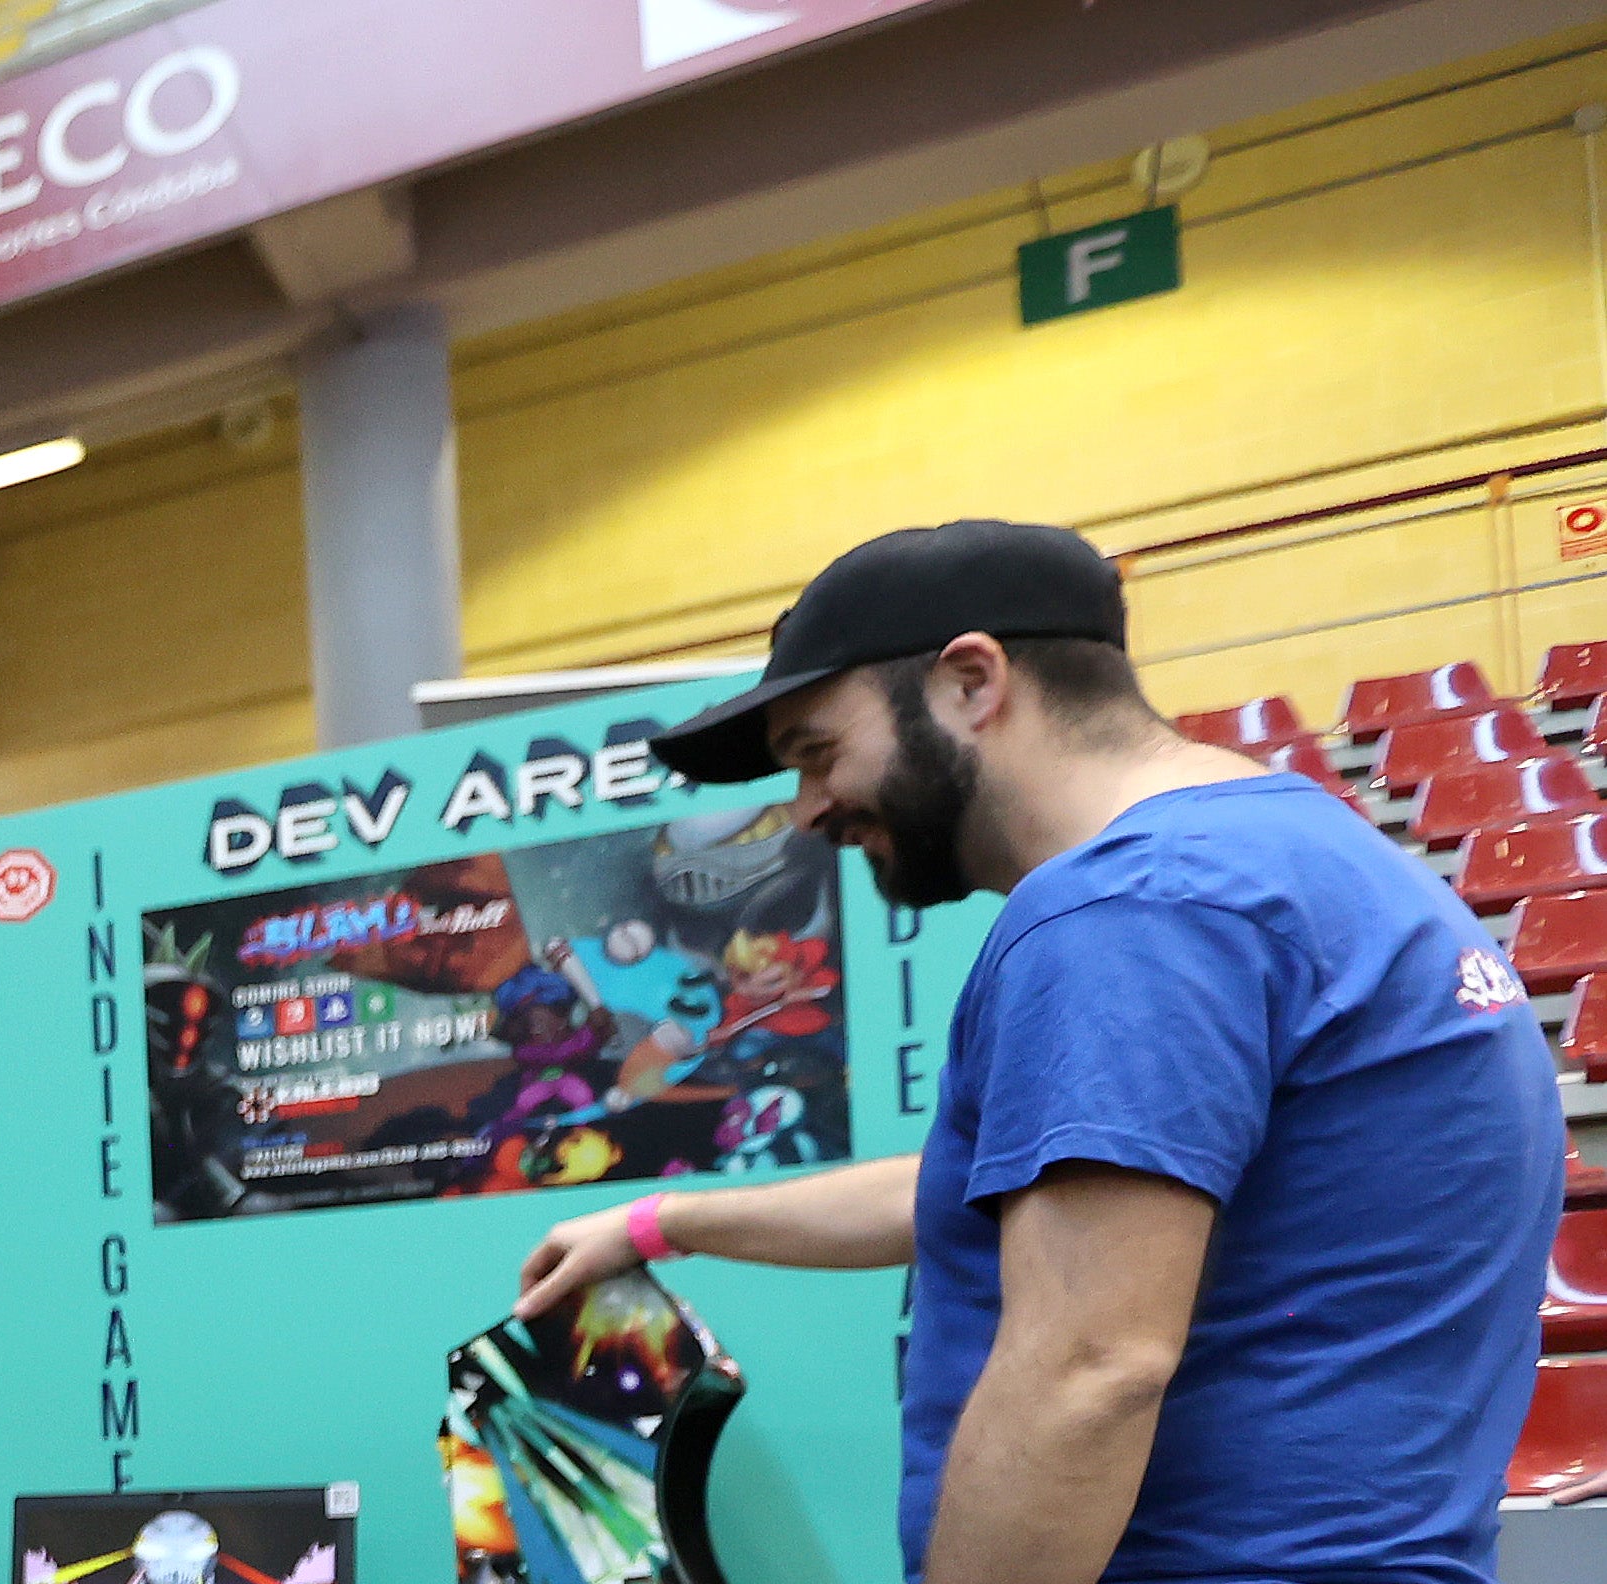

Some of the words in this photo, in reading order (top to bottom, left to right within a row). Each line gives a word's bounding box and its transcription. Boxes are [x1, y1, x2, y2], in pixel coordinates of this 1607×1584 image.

[1064, 228, 1128, 305] F
[204, 769, 411, 875] DEV
[87, 850, 120, 1198] INDIE
[236, 1028, 367, 1072] WISHLIST
[375, 1021, 403, 1053] IT
[413, 1010, 489, 1047] NOW!
[887, 905, 928, 1116] DIE
[100, 1237, 142, 1492] GAME
